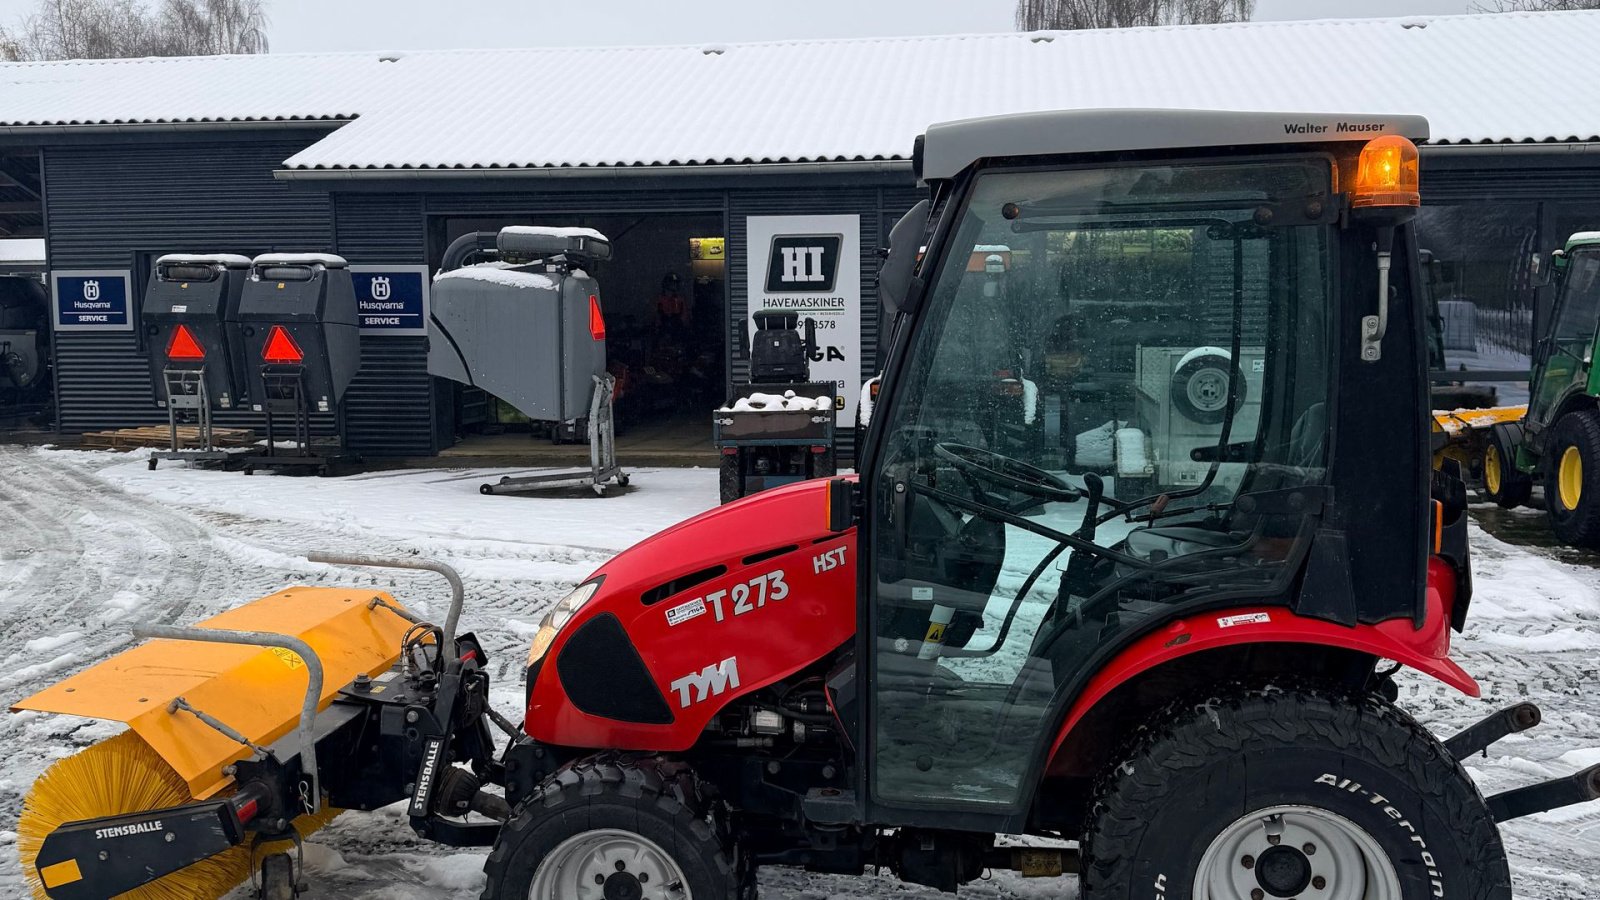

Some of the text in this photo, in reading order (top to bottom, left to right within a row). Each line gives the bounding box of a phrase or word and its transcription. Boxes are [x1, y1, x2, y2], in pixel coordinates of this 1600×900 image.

[1284, 122, 1385, 134] Walter Mauser
[781, 247, 825, 282] HI
[74, 301, 111, 309] Husqvarna
[359, 301, 404, 310] Husqvarna
[763, 298, 845, 307] HAVEMASKINER
[365, 317, 400, 325] SERVICE
[812, 545, 847, 575] HST
[670, 656, 740, 709] TYM
[415, 741, 439, 809] STENSBALLE
[95, 820, 163, 839] STENSBALLE
